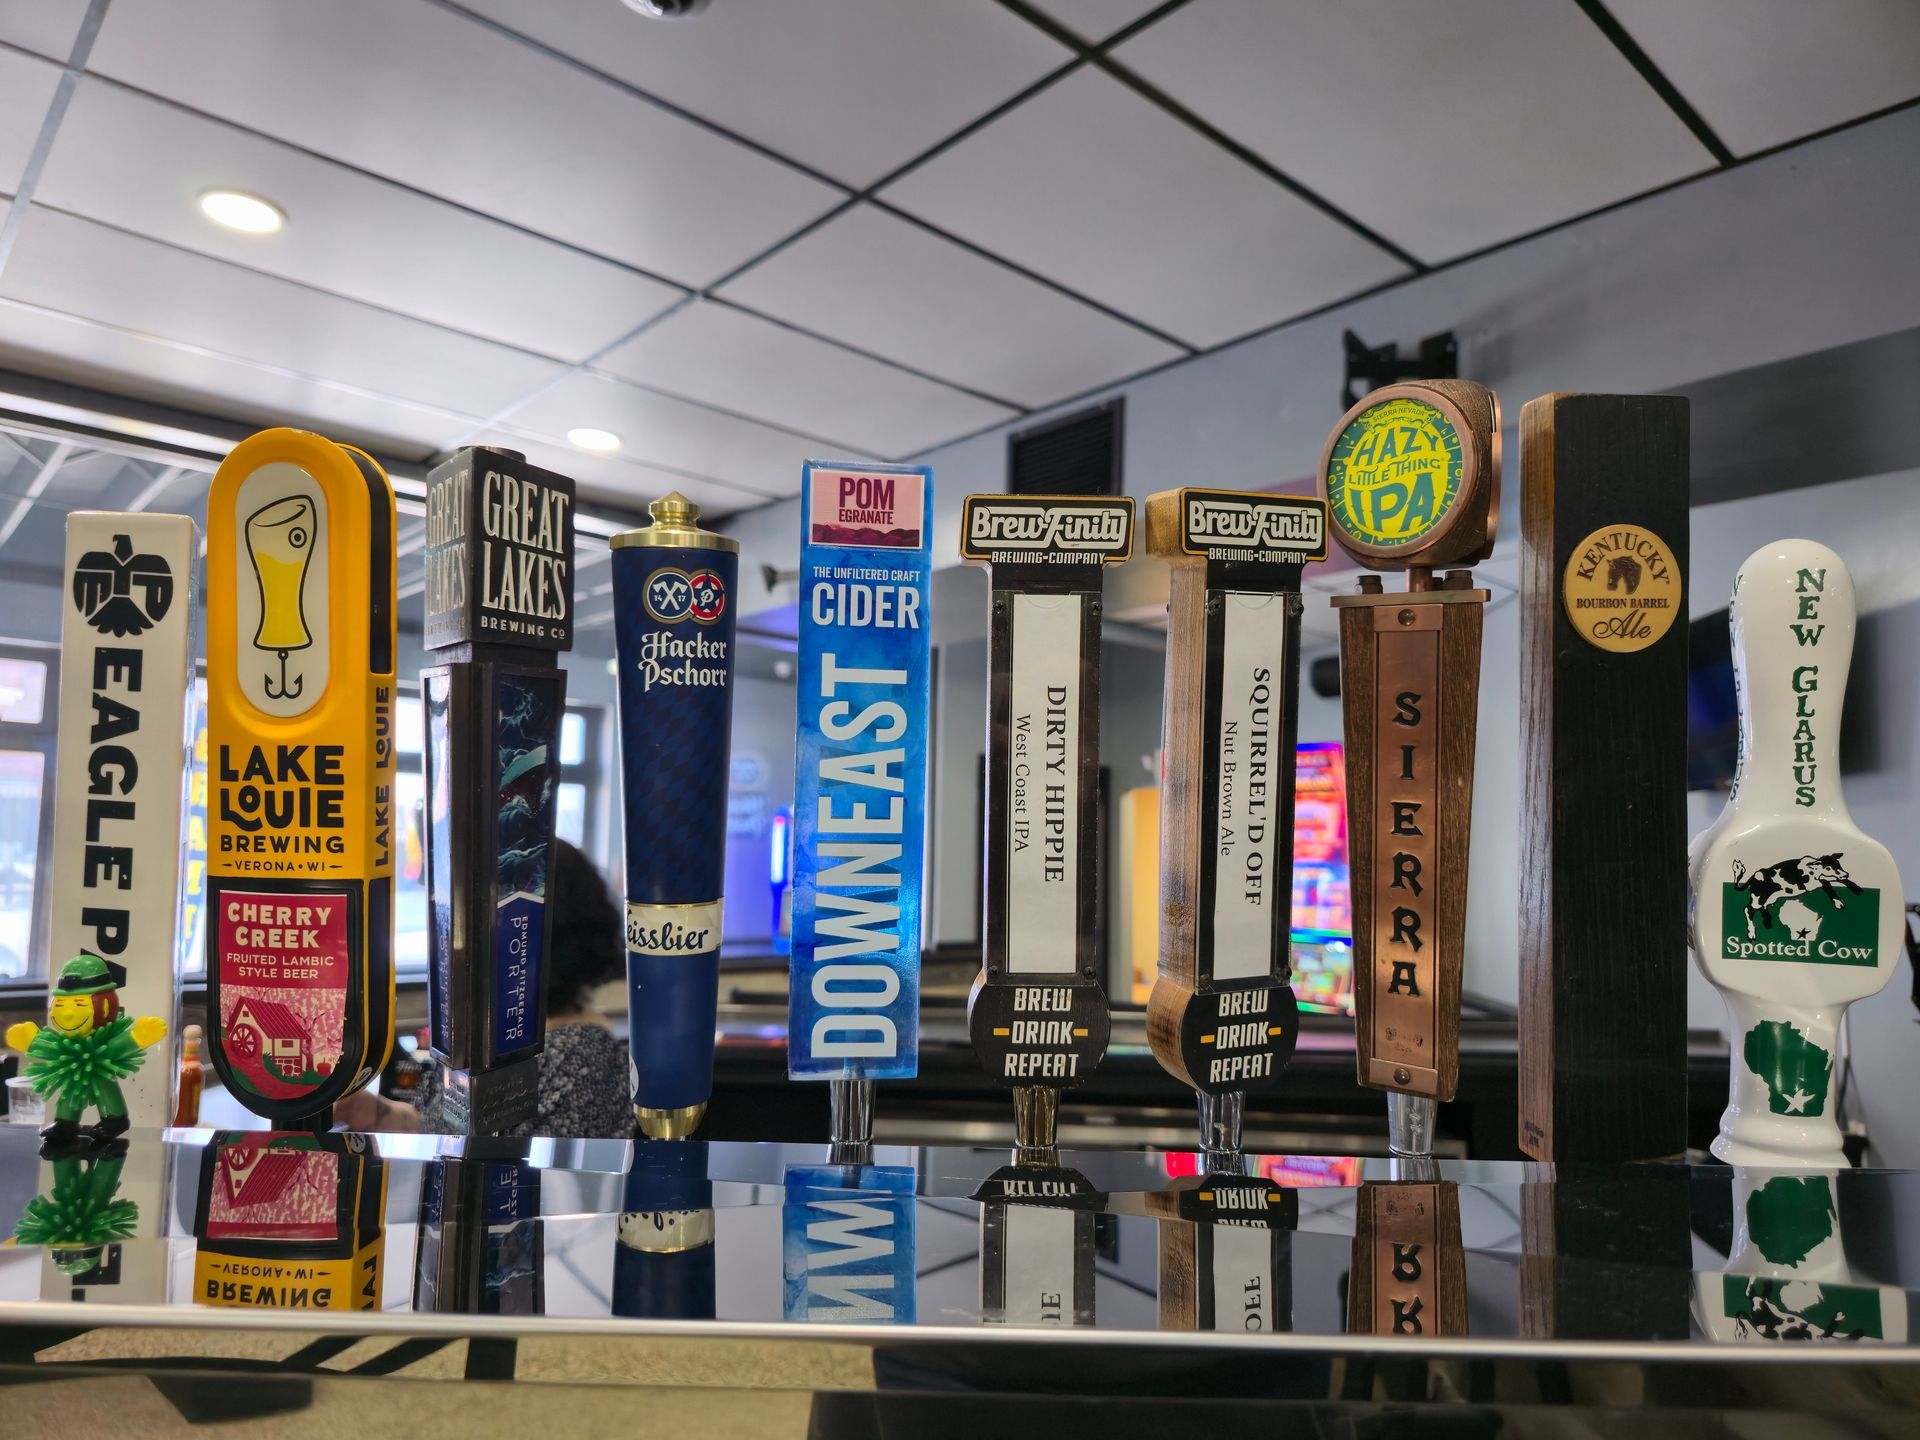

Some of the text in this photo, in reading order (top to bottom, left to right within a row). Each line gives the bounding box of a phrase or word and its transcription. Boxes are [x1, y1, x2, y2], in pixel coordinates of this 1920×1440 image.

[1373, 407, 1425, 422] SIERRA NEVADA
[1352, 426, 1439, 466] HAZY
[1348, 455, 1441, 485] LITTLE THING
[838, 477, 895, 510] POM
[1350, 472, 1435, 532] IPA
[483, 470, 569, 554] GREAT
[838, 508, 894, 525] EGRANATE
[813, 566, 920, 583] THE UNFILTERED CRAFT
[1576, 532, 1670, 584] KENTUCKY
[482, 541, 566, 620] LAKES
[812, 583, 920, 629] CIDER
[1576, 598, 1670, 609] BOURBON BARREL
[481, 615, 545, 637] BREWING
[1592, 609, 1652, 639] Ale
[641, 631, 727, 660] Hacker
[638, 659, 727, 692] Pschorr
[1789, 568, 1826, 807] NEW GLARUS
[84, 647, 143, 890] EAGLE
[220, 744, 344, 786] LAKE
[375, 686, 392, 867] LAKE LOUIE
[1014, 713, 1031, 853] West Coast IPA
[1044, 685, 1067, 882] DIRTY HIPPIE
[1220, 720, 1238, 857] Nut Brown Ale
[1244, 667, 1271, 906] SQUIRREL'D OFF
[220, 785, 344, 832] LOUIE
[220, 835, 345, 854] BREWING
[811, 653, 907, 1058] DOWNEAST
[1388, 691, 1424, 997] SIERRA
[235, 861, 326, 872] VERONA WI
[227, 901, 333, 927] CHERRY
[627, 909, 709, 951] eissbier
[235, 926, 320, 949] CREEK
[1726, 936, 1873, 960] Spotted Cow
[227, 953, 335, 967] FRUITED LAMBIC
[238, 967, 319, 979] STYLE BEER
[517, 915, 528, 1037] EDMUND FITZGERALD
[505, 916, 521, 1041] PORTER
[1014, 988, 1073, 1012] BREW
[1218, 989, 1269, 1018] BREW
[1011, 1021, 1074, 1045] DRINK
[1216, 1021, 1269, 1050] DRINK
[1004, 1053, 1079, 1078] REPEAT
[1210, 1053, 1274, 1083] REPEAT
